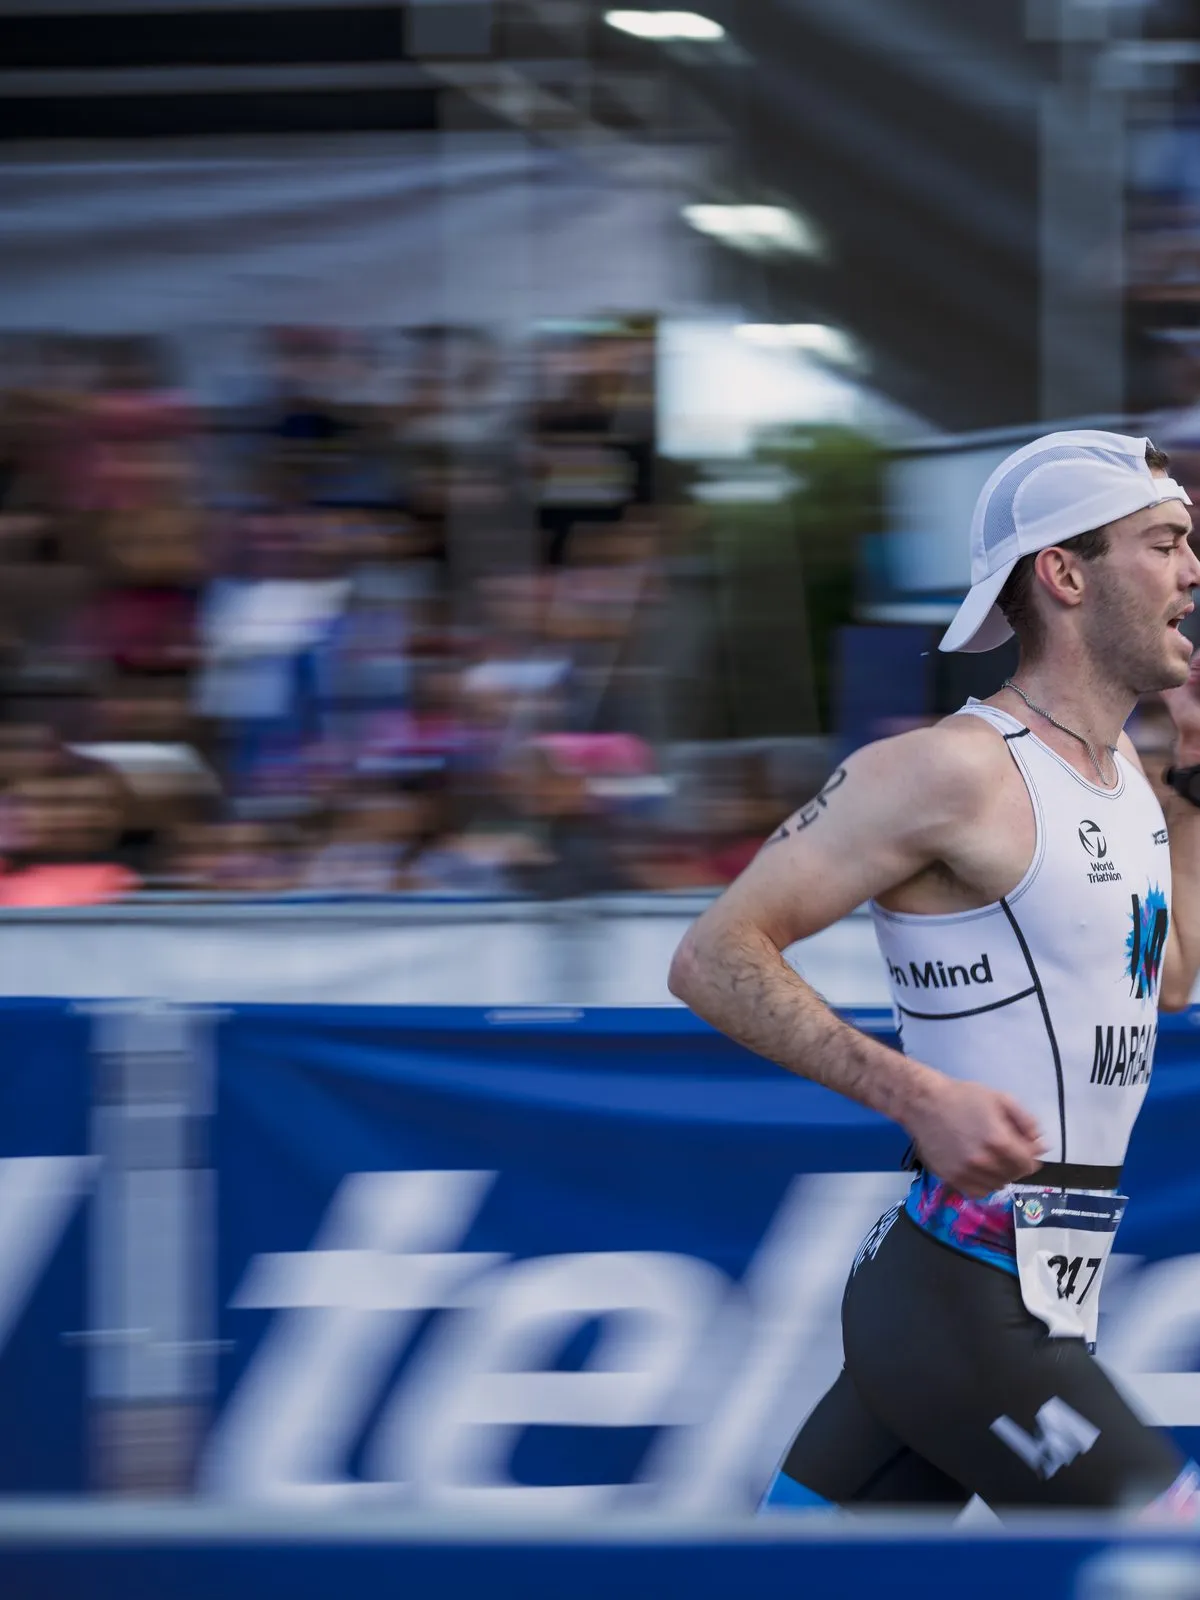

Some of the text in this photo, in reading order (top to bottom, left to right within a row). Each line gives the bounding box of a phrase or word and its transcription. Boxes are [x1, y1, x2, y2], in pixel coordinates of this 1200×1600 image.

[1090, 861, 1115, 872] World
[1087, 871, 1122, 884] Triathlon
[909, 952, 994, 989] Mind
